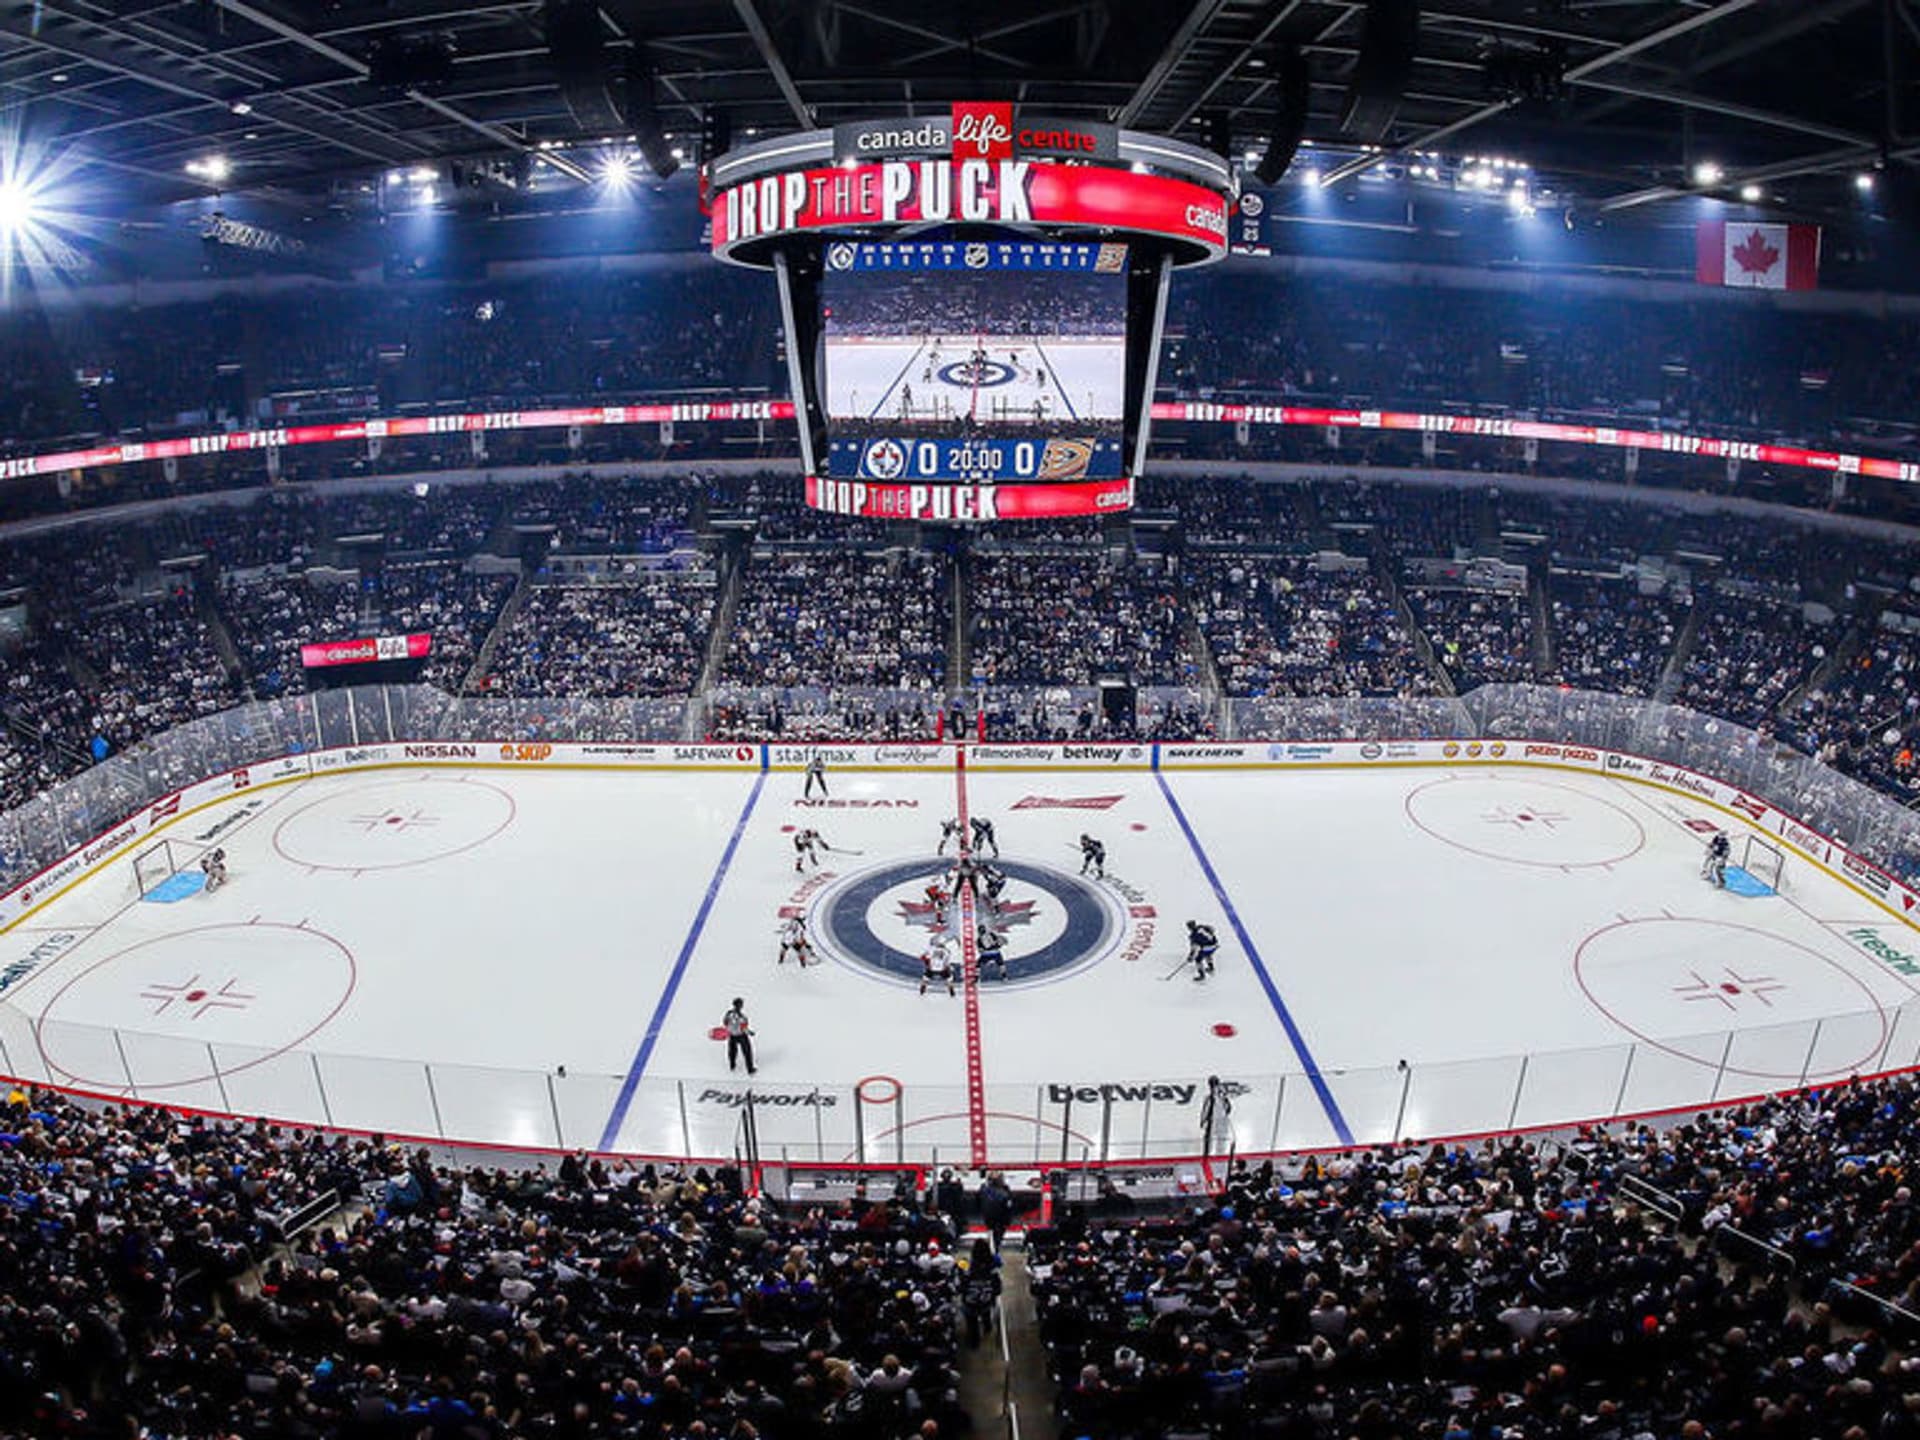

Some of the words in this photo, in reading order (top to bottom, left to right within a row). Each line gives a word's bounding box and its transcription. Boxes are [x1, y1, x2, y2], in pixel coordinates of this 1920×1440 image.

[857, 124, 946, 149] canada
[954, 114, 1012, 153] life
[1018, 128, 1097, 150] centre
[727, 172, 806, 241] DROP
[812, 173, 873, 218] THE
[882, 160, 1033, 222] PUCK
[919, 442, 937, 474] 0
[950, 449, 1001, 470] 20:00
[1016, 442, 1034, 474] 0
[870, 487, 906, 514] THE
[910, 484, 998, 520] PUCK
[404, 745, 476, 758] NISSAN
[515, 744, 552, 760] SKIP
[673, 747, 733, 761] SAFEWAY
[775, 747, 856, 762] staffmax
[1062, 746, 1122, 762] betway
[794, 799, 919, 808] NISSAN
[698, 1089, 838, 1108] Payworks
[1048, 1084, 1197, 1105] betway
